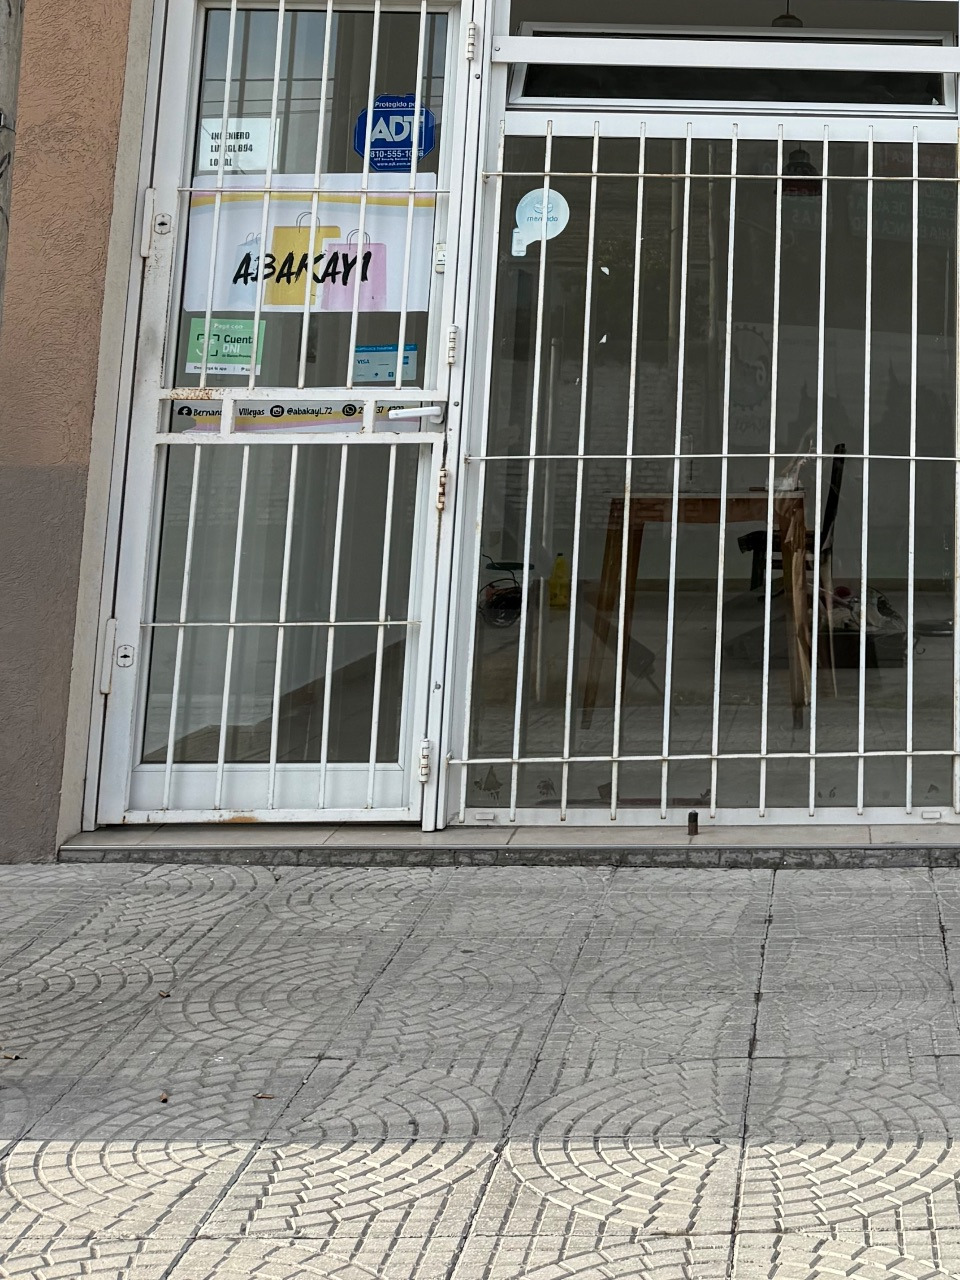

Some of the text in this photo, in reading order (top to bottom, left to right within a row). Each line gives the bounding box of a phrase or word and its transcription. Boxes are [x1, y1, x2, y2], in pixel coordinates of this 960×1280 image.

[370, 115, 425, 142] ADT
[209, 158, 232, 166] LOAL
[222, 343, 240, 354] DNI
[238, 408, 265, 419] Villegas
